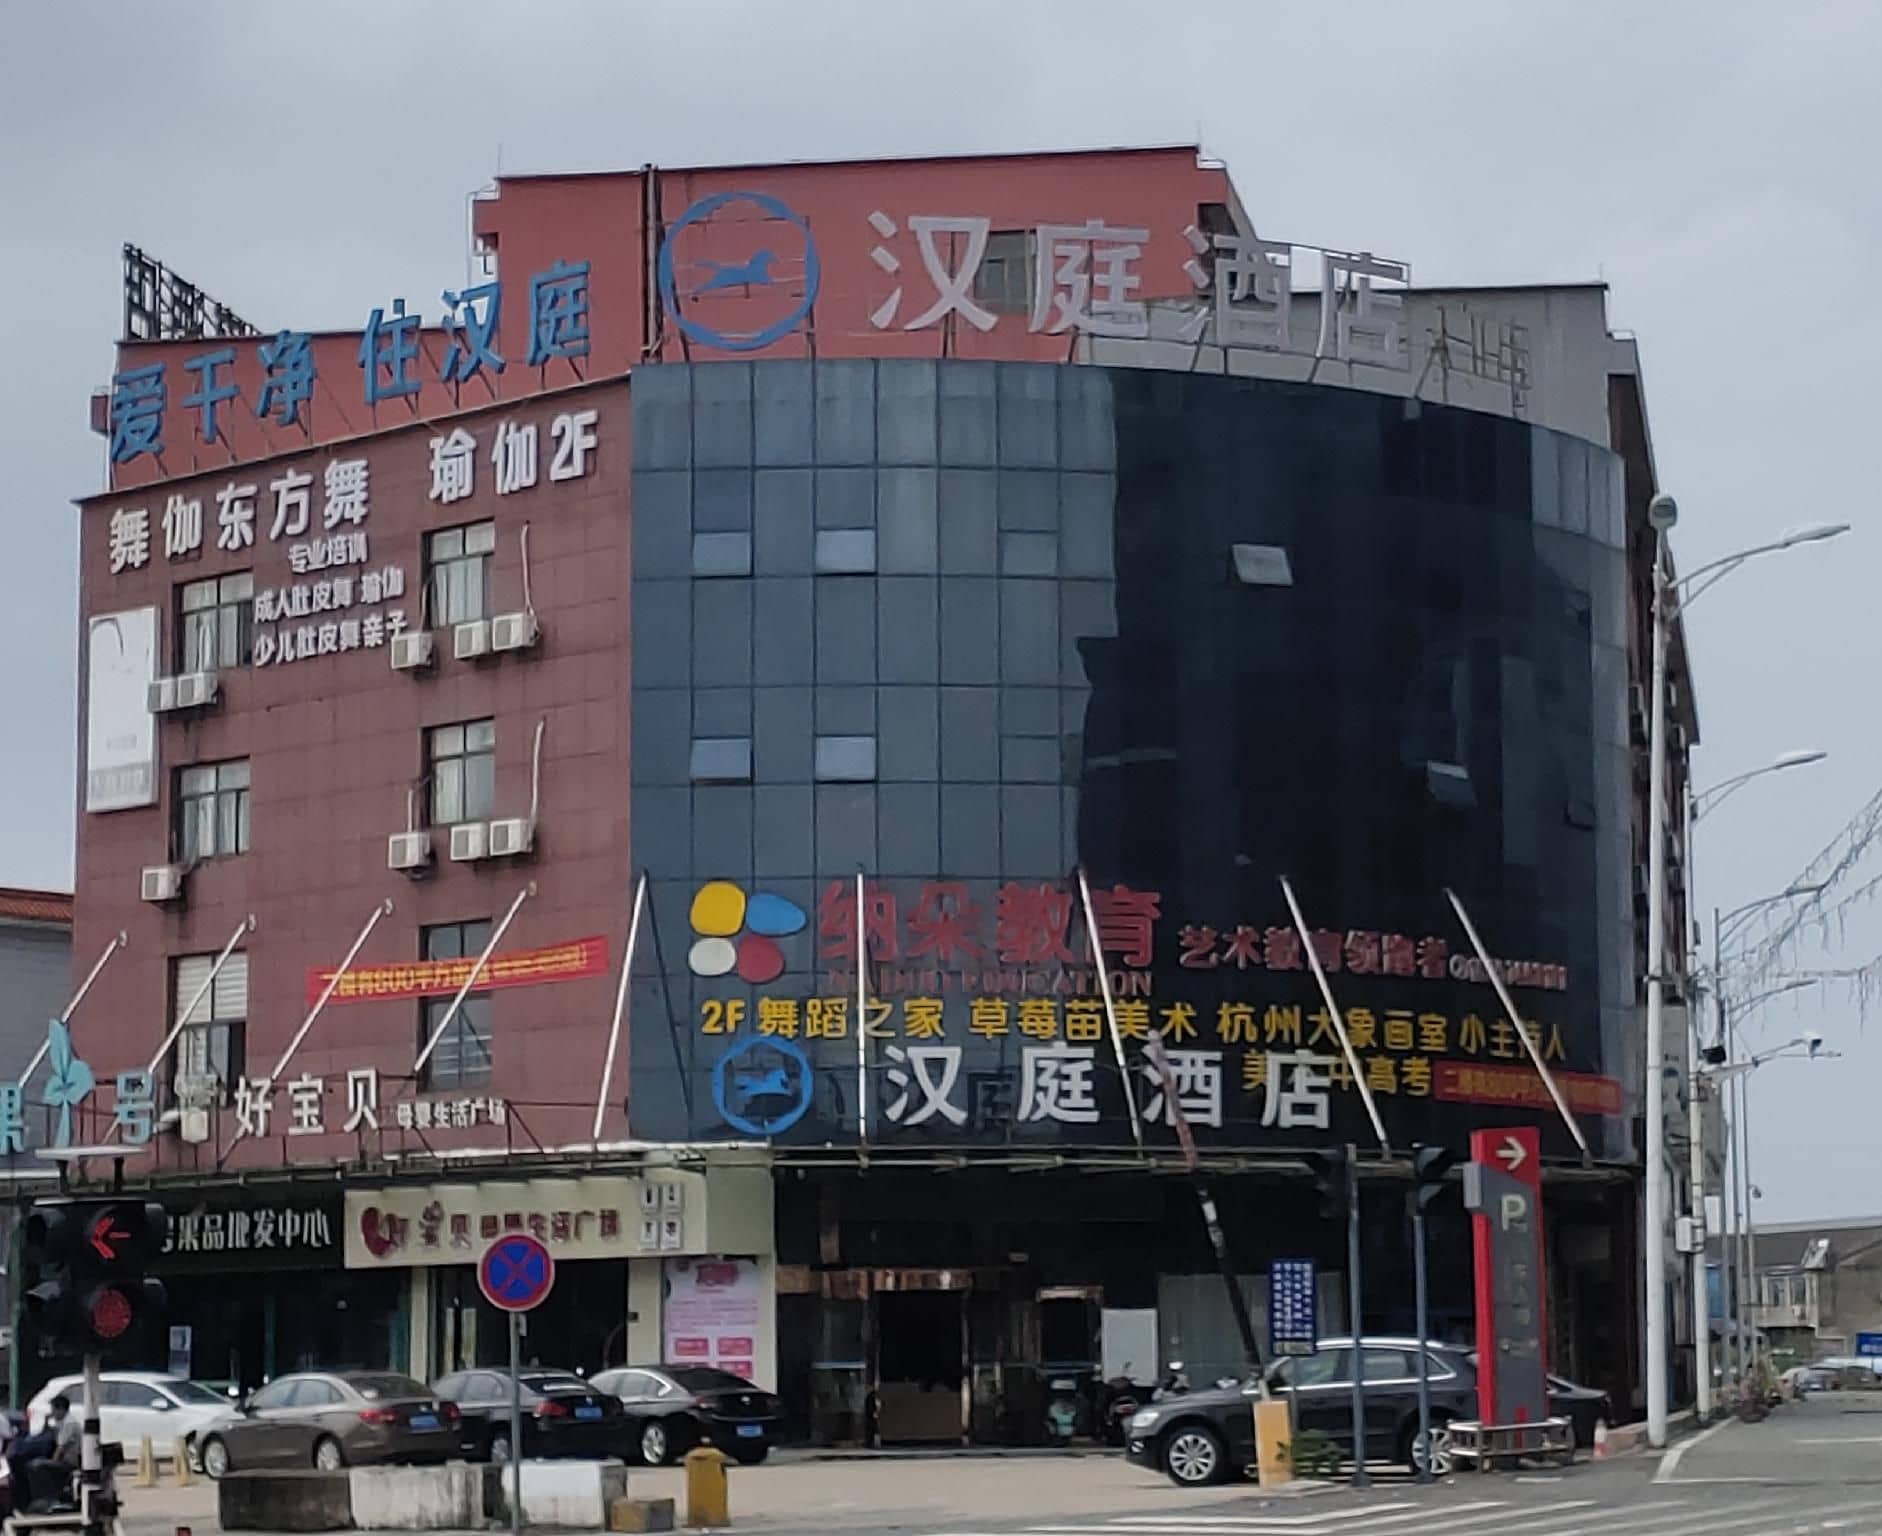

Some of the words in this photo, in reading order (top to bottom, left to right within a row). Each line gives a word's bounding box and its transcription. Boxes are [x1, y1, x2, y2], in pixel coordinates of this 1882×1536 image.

[868, 208, 1410, 368] 汉庭酒店
[110, 330, 317, 463] 爱干净
[358, 259, 591, 405] 住汉庭
[109, 459, 369, 574] 舞伽东方舞
[288, 532, 368, 573] 专业培训
[819, 880, 1161, 967] 纳朵教育
[701, 1002, 744, 1035] 2F
[757, 997, 946, 1040] 舞蹈之家
[969, 1000, 1198, 1042] 草莓苗美术
[1217, 1003, 1449, 1052] 杭州大象画室
[234, 1067, 379, 1138] 好宝贝
[396, 1096, 506, 1131] 母婴生活广场
[884, 1042, 1334, 1131] 汉庭酒店
[1500, 1193, 1527, 1232] P
